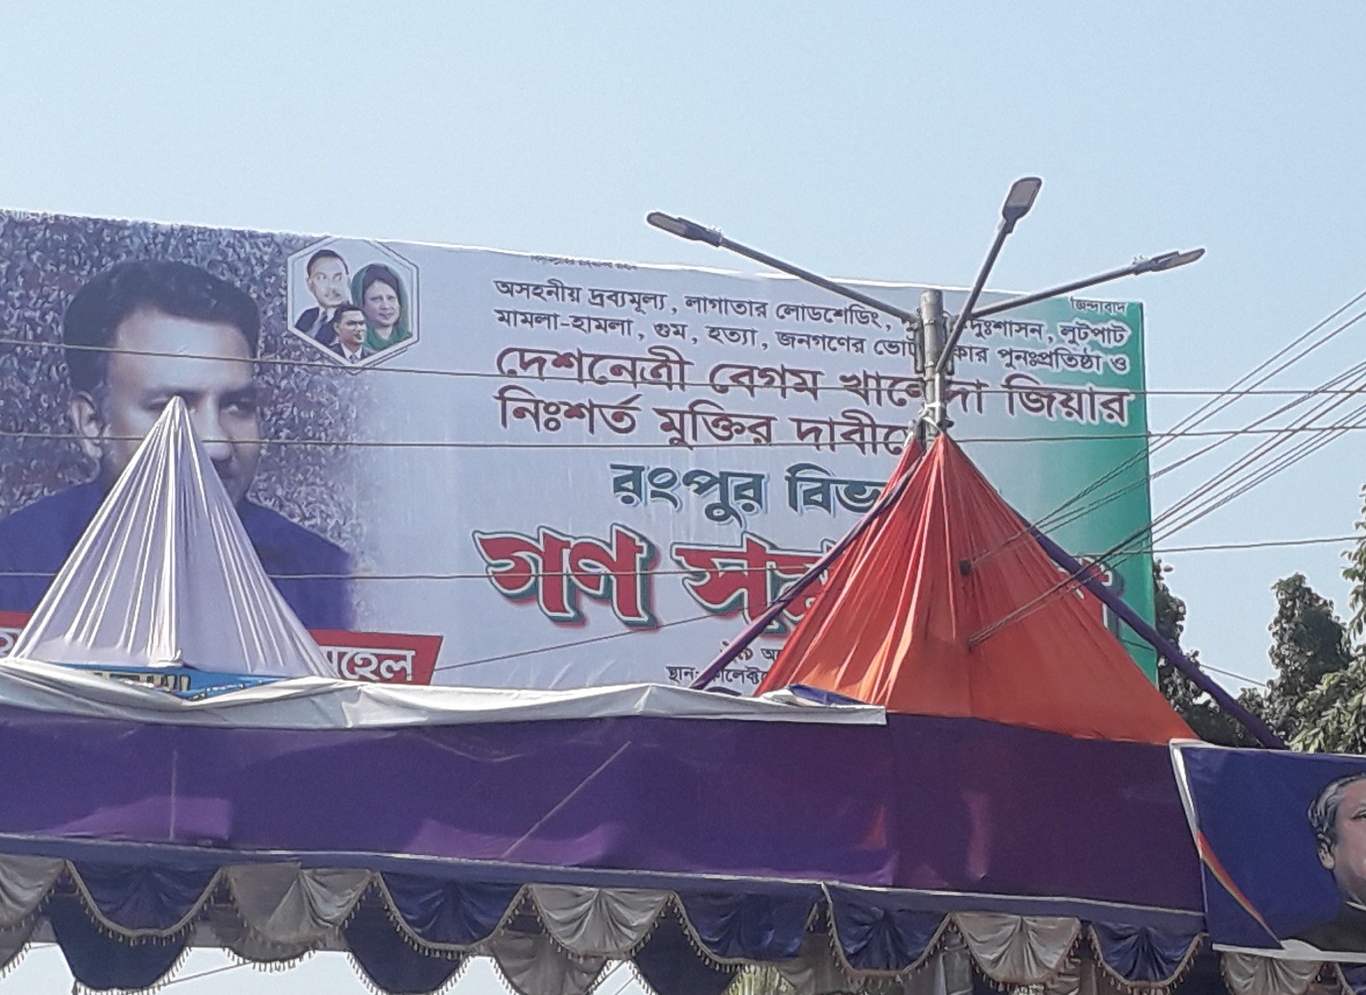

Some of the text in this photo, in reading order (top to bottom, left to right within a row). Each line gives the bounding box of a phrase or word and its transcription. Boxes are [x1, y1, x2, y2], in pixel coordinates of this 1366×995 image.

[493, 279, 582, 304] অসহনীয়
[685, 294, 768, 320] লাগাতার
[776, 329, 866, 357] জনগণের
[996, 346, 1103, 372] পুনঃপ্রতিষ্ঠা
[1109, 355, 1129, 373] ও
[1060, 320, 1129, 347] লুটপাট
[493, 384, 642, 436] নিঃশর্ত
[652, 398, 778, 451] মুক্তির
[496, 345, 694, 393] দেশনেত্রী
[708, 362, 825, 401] বেগম
[1001, 372, 1131, 425] জিয়ার
[609, 461, 771, 530] রংপুর
[471, 521, 661, 630] গণ
